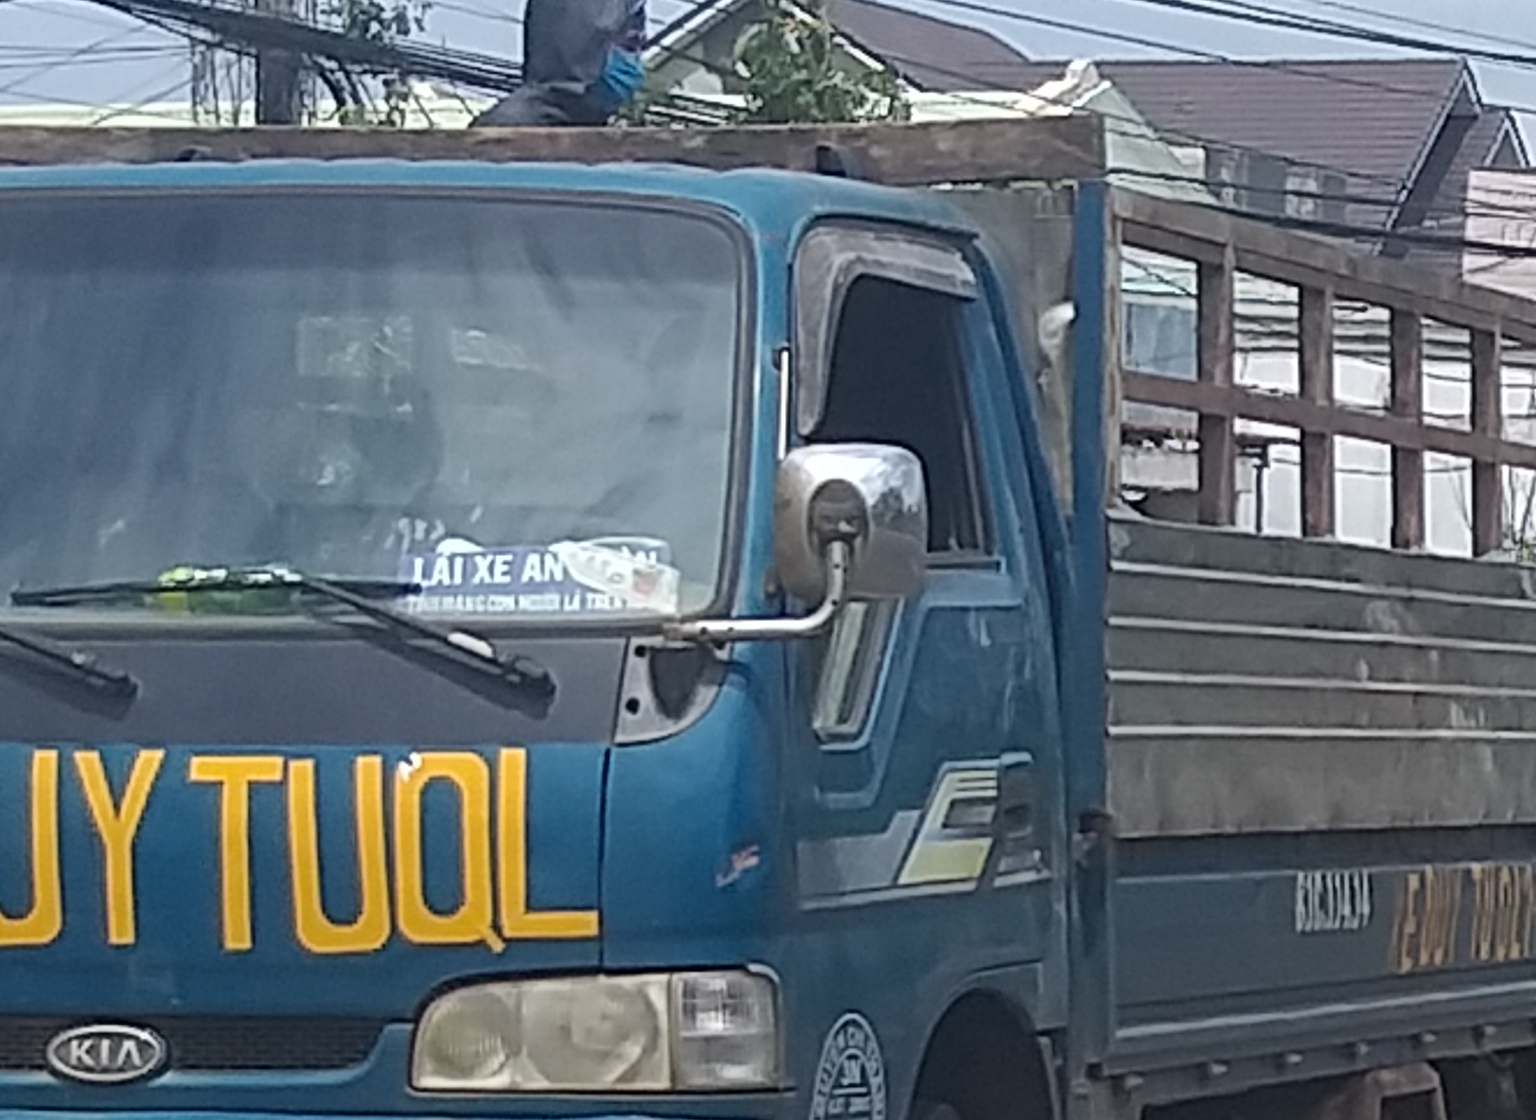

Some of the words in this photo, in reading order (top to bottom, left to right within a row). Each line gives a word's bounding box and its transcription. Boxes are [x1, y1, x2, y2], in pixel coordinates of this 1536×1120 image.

[471, 554, 514, 584] XE
[521, 553, 564, 583] AN
[188, 747, 600, 955] TUQL
[69, 1039, 142, 1067] KIA
